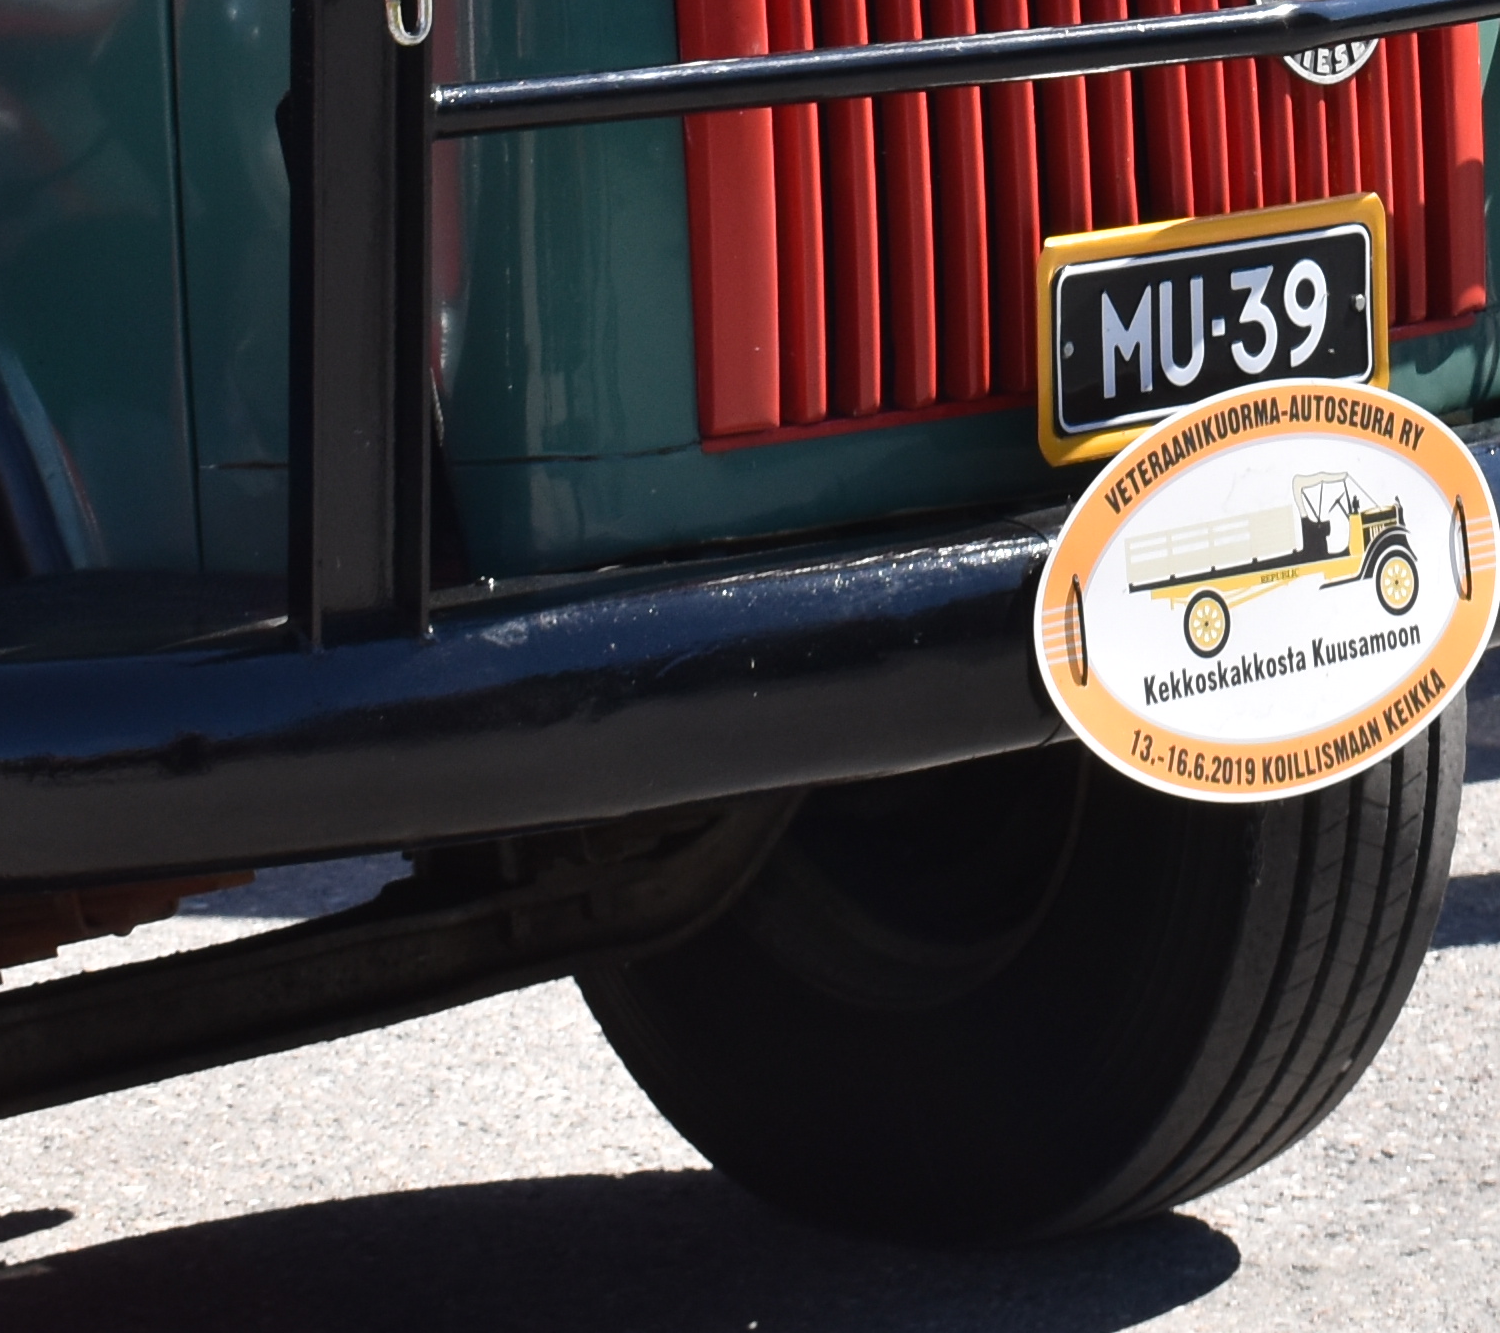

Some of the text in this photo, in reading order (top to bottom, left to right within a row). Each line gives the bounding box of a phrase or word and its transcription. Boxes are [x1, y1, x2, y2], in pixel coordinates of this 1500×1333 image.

[1101, 259, 1328, 399] MU-39
[1104, 394, 1425, 514] VETERAANIKUORMA-AUTOSEURA RY
[1260, 568, 1300, 584] REPUBLIC
[1143, 623, 1421, 706] Kekkoskakkosta Kuusamoon
[1130, 667, 1447, 786] 13.-16.6.2019 KOILLISMAAN KEIKKA
